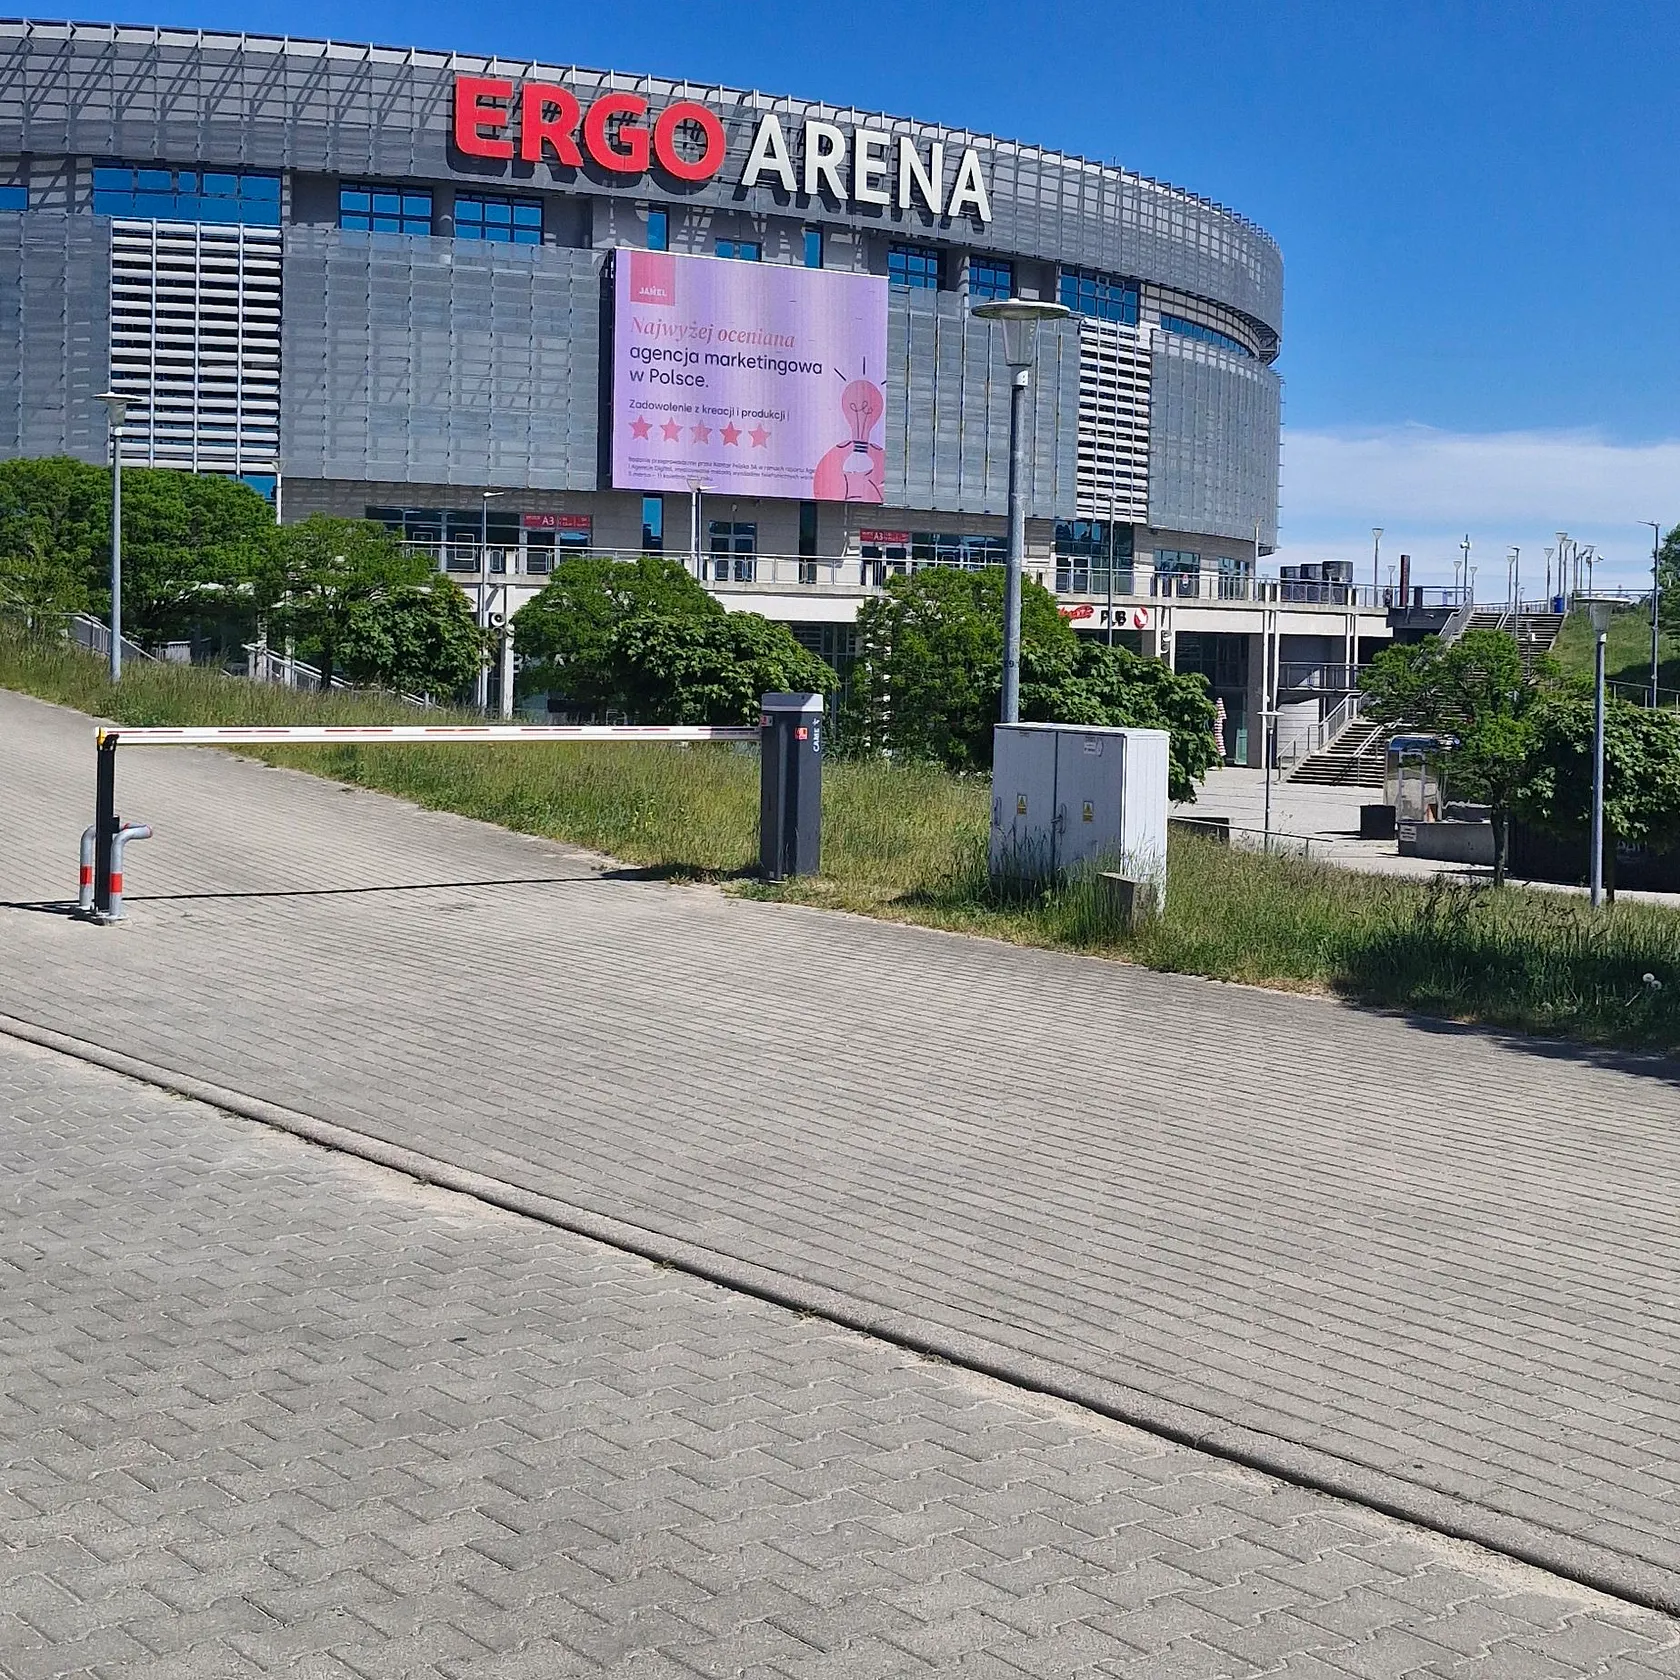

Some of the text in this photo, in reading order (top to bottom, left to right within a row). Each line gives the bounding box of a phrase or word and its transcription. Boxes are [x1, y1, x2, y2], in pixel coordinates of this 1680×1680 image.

[454, 74, 992, 222] ERGO ARENA
[630, 316, 796, 348] Najwyżej oceniana
[629, 346, 823, 376] agencja marketingowa
[629, 368, 710, 388] w Polsce.
[628, 399, 693, 414] Zadowolenie
[694, 405, 700, 414] z
[701, 404, 736, 418] kreacji
[740, 408, 786, 422] produkcji
[541, 515, 555, 526] A3
[873, 531, 884, 541] A3
[812, 727, 821, 753] CAME
